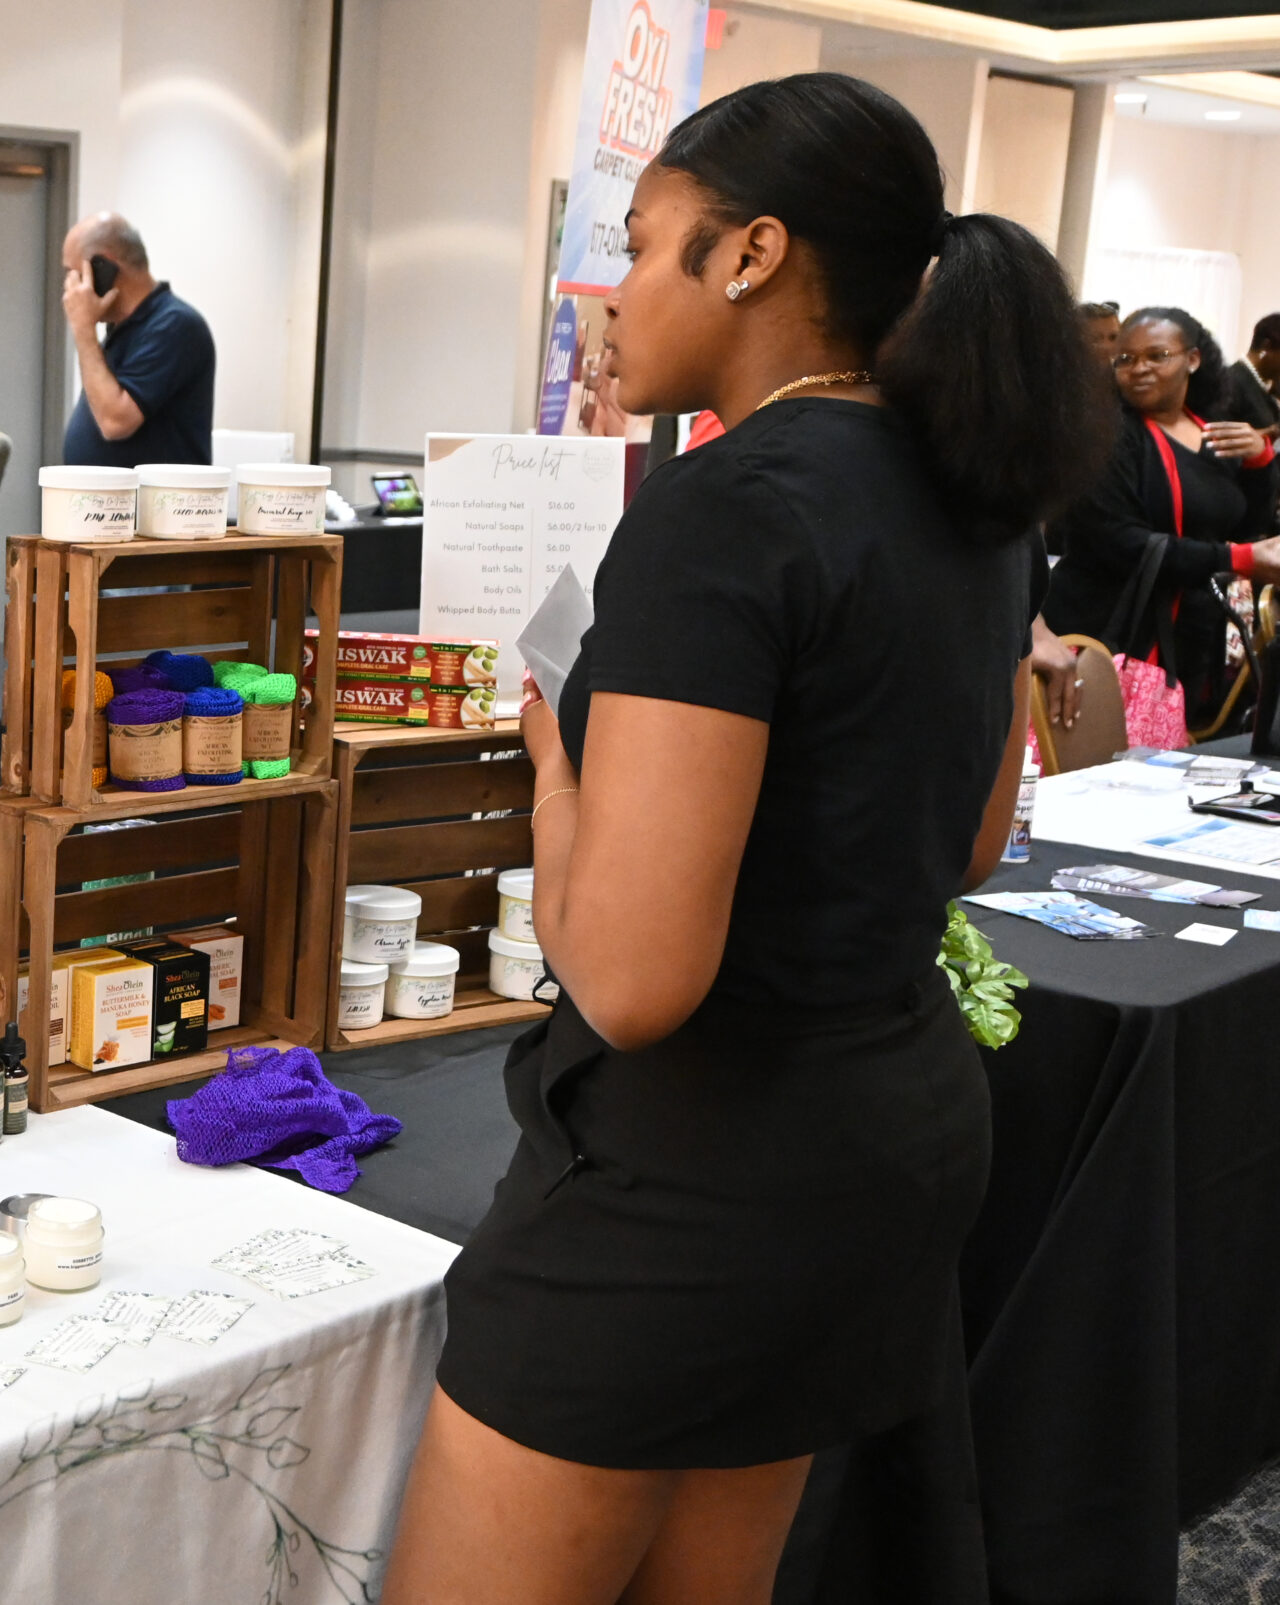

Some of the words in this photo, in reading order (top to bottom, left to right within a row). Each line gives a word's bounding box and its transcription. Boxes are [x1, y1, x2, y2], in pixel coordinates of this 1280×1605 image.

[623, 5, 669, 94] OXI
[601, 69, 671, 155] FRESH
[594, 147, 625, 178] CARPET
[492, 443, 537, 479] Price
[538, 446, 576, 480] list
[430, 498, 460, 509] African
[463, 500, 507, 511] Exfoliating
[509, 501, 525, 510] Net
[465, 522, 497, 531] Natural
[499, 523, 524, 533] Soaps
[584, 523, 595, 532] for
[598, 524, 607, 532] 10
[443, 542, 475, 552] Natural
[478, 543, 524, 553] Toothpaste
[481, 565, 501, 574] Bath
[503, 565, 523, 574] Salts
[546, 565, 564, 573] $5.0
[484, 586, 505, 596] Body
[506, 586, 522, 594] Oils
[437, 605, 475, 616] Whipped
[477, 605, 498, 615] Body
[336, 647, 407, 664] ISWAK
[335, 689, 405, 706] ISWAK
[169, 984, 196, 993] AFRICAN
[102, 994, 140, 1006] BUTTERMILK
[164, 993, 183, 1003] BLACK
[184, 989, 201, 998] SOAP
[100, 1003, 128, 1014] MANUKA
[128, 1000, 150, 1008] HONEY
[115, 1010, 132, 1018] SOAP
